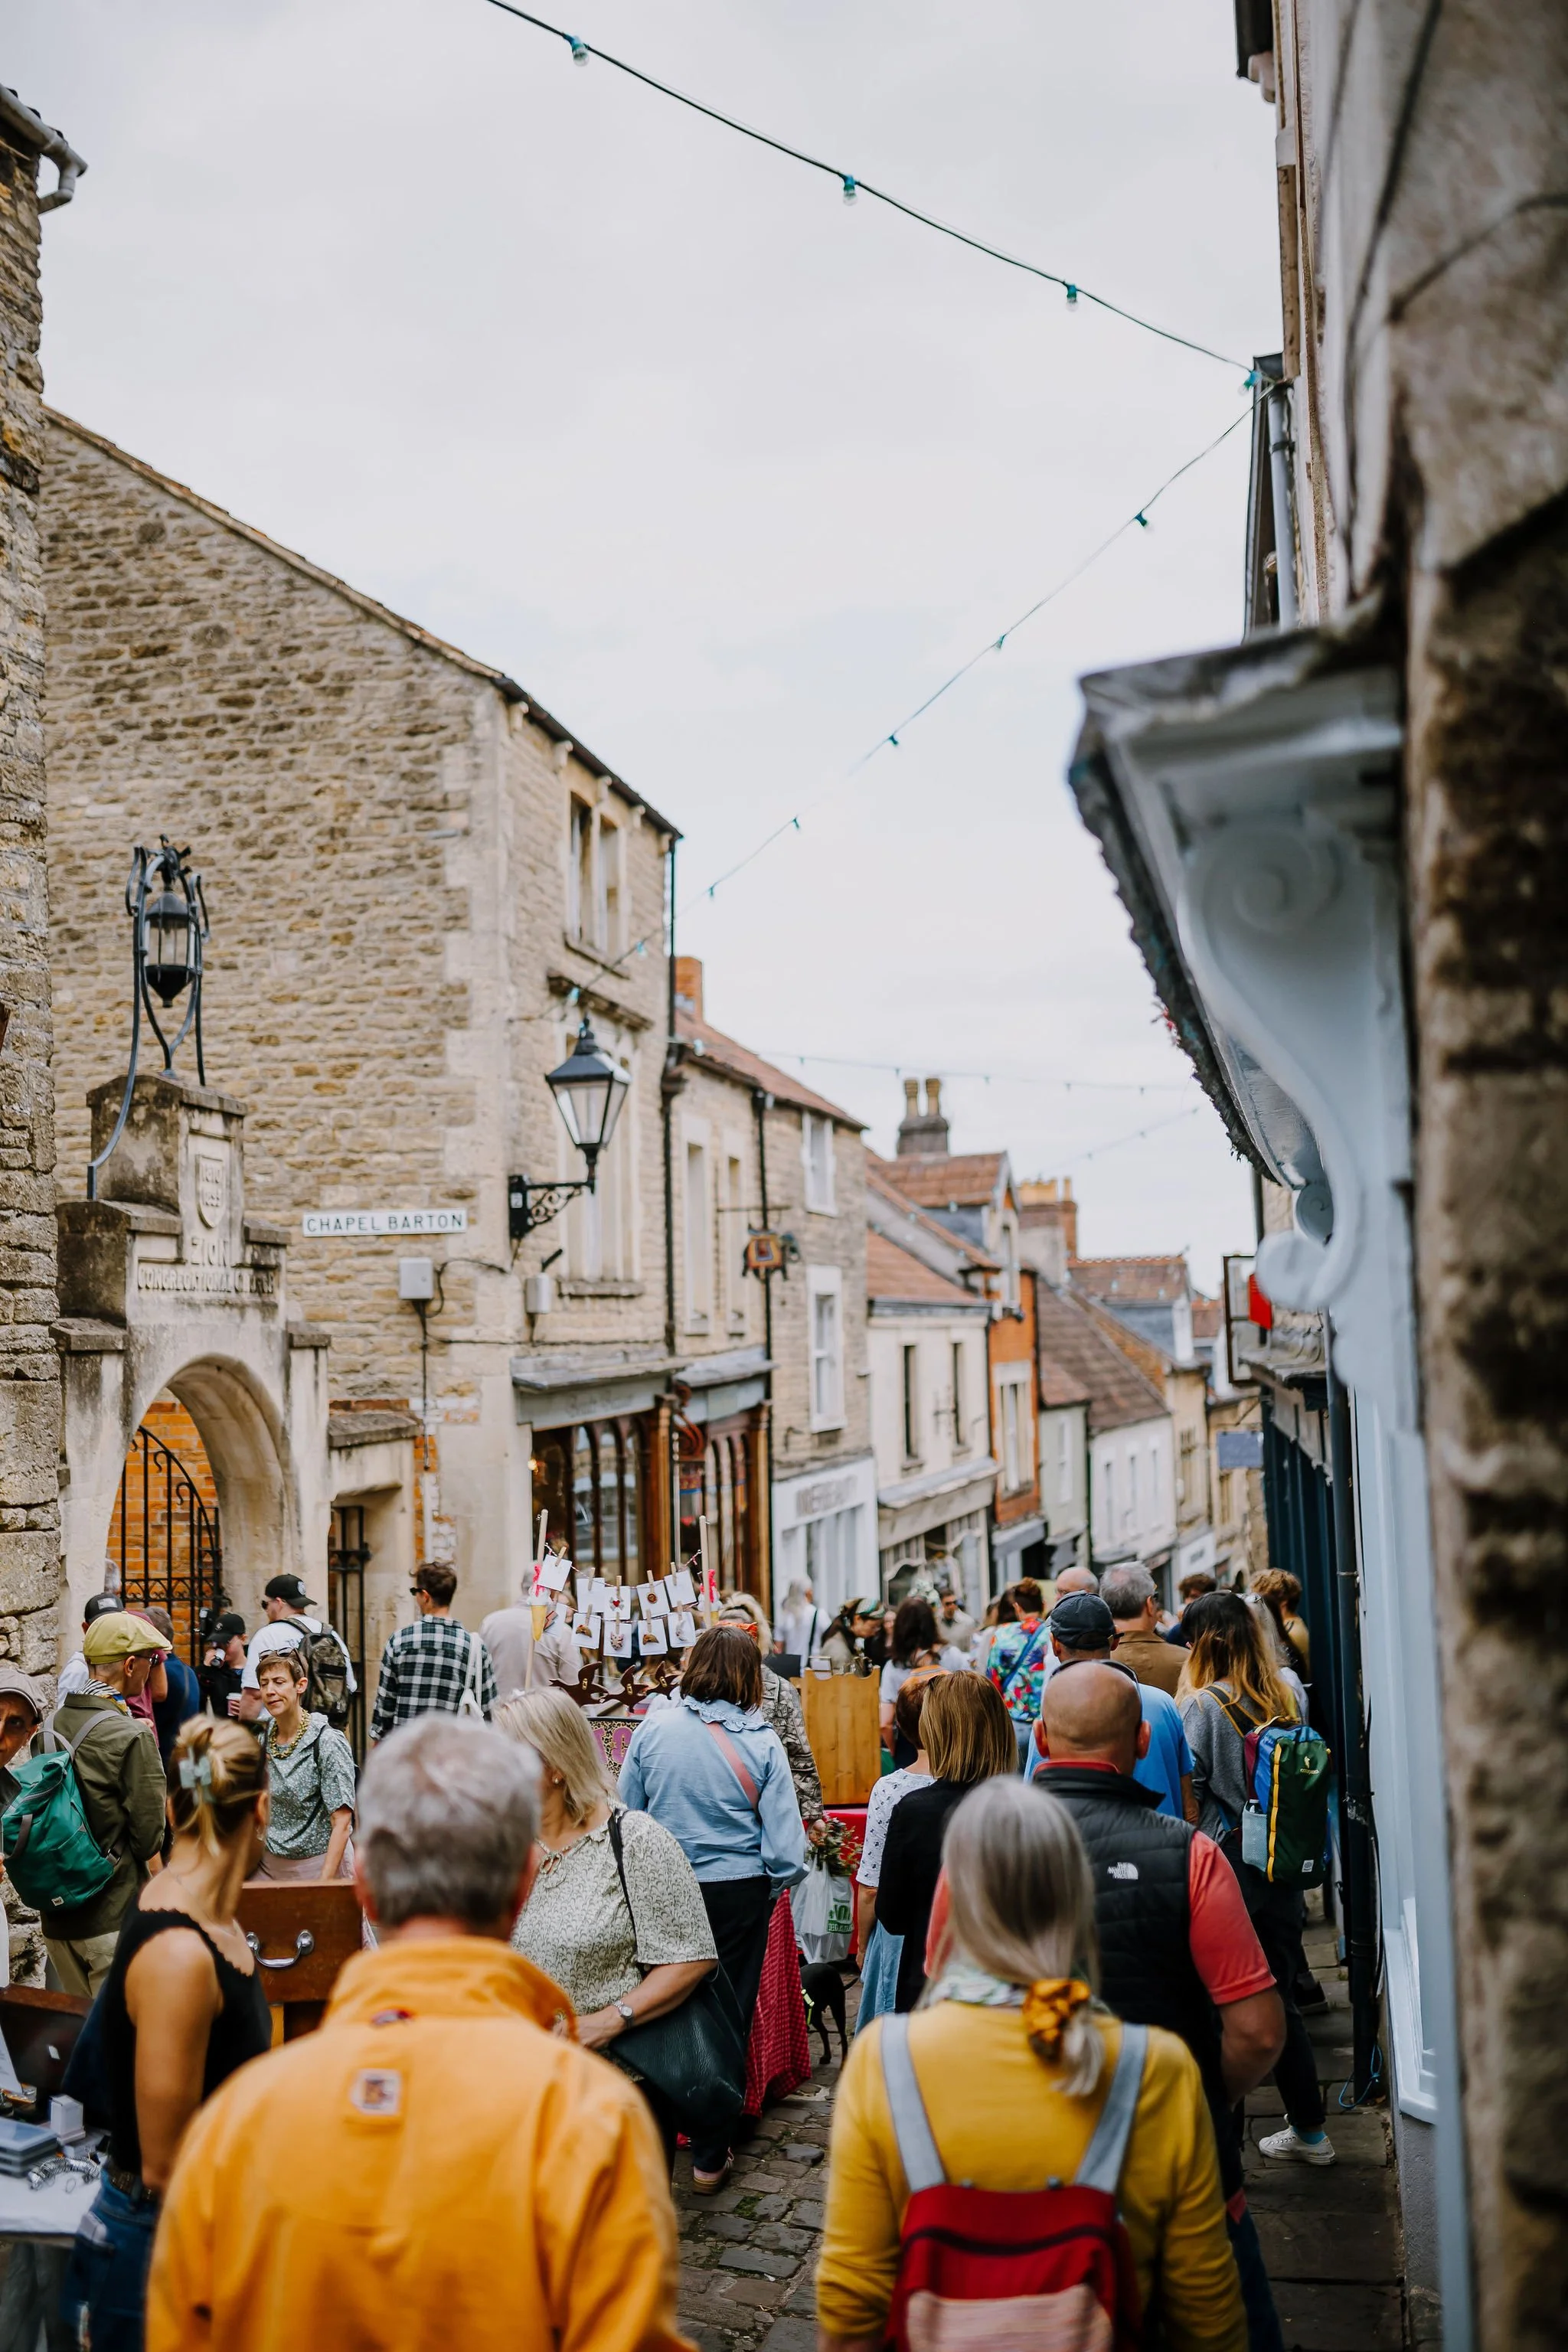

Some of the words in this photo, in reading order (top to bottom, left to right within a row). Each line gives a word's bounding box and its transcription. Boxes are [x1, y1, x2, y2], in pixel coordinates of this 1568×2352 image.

[307, 1217, 381, 1233] CHAPEL
[388, 1215, 462, 1230] BARTON
[191, 1237, 229, 1266] ZION
